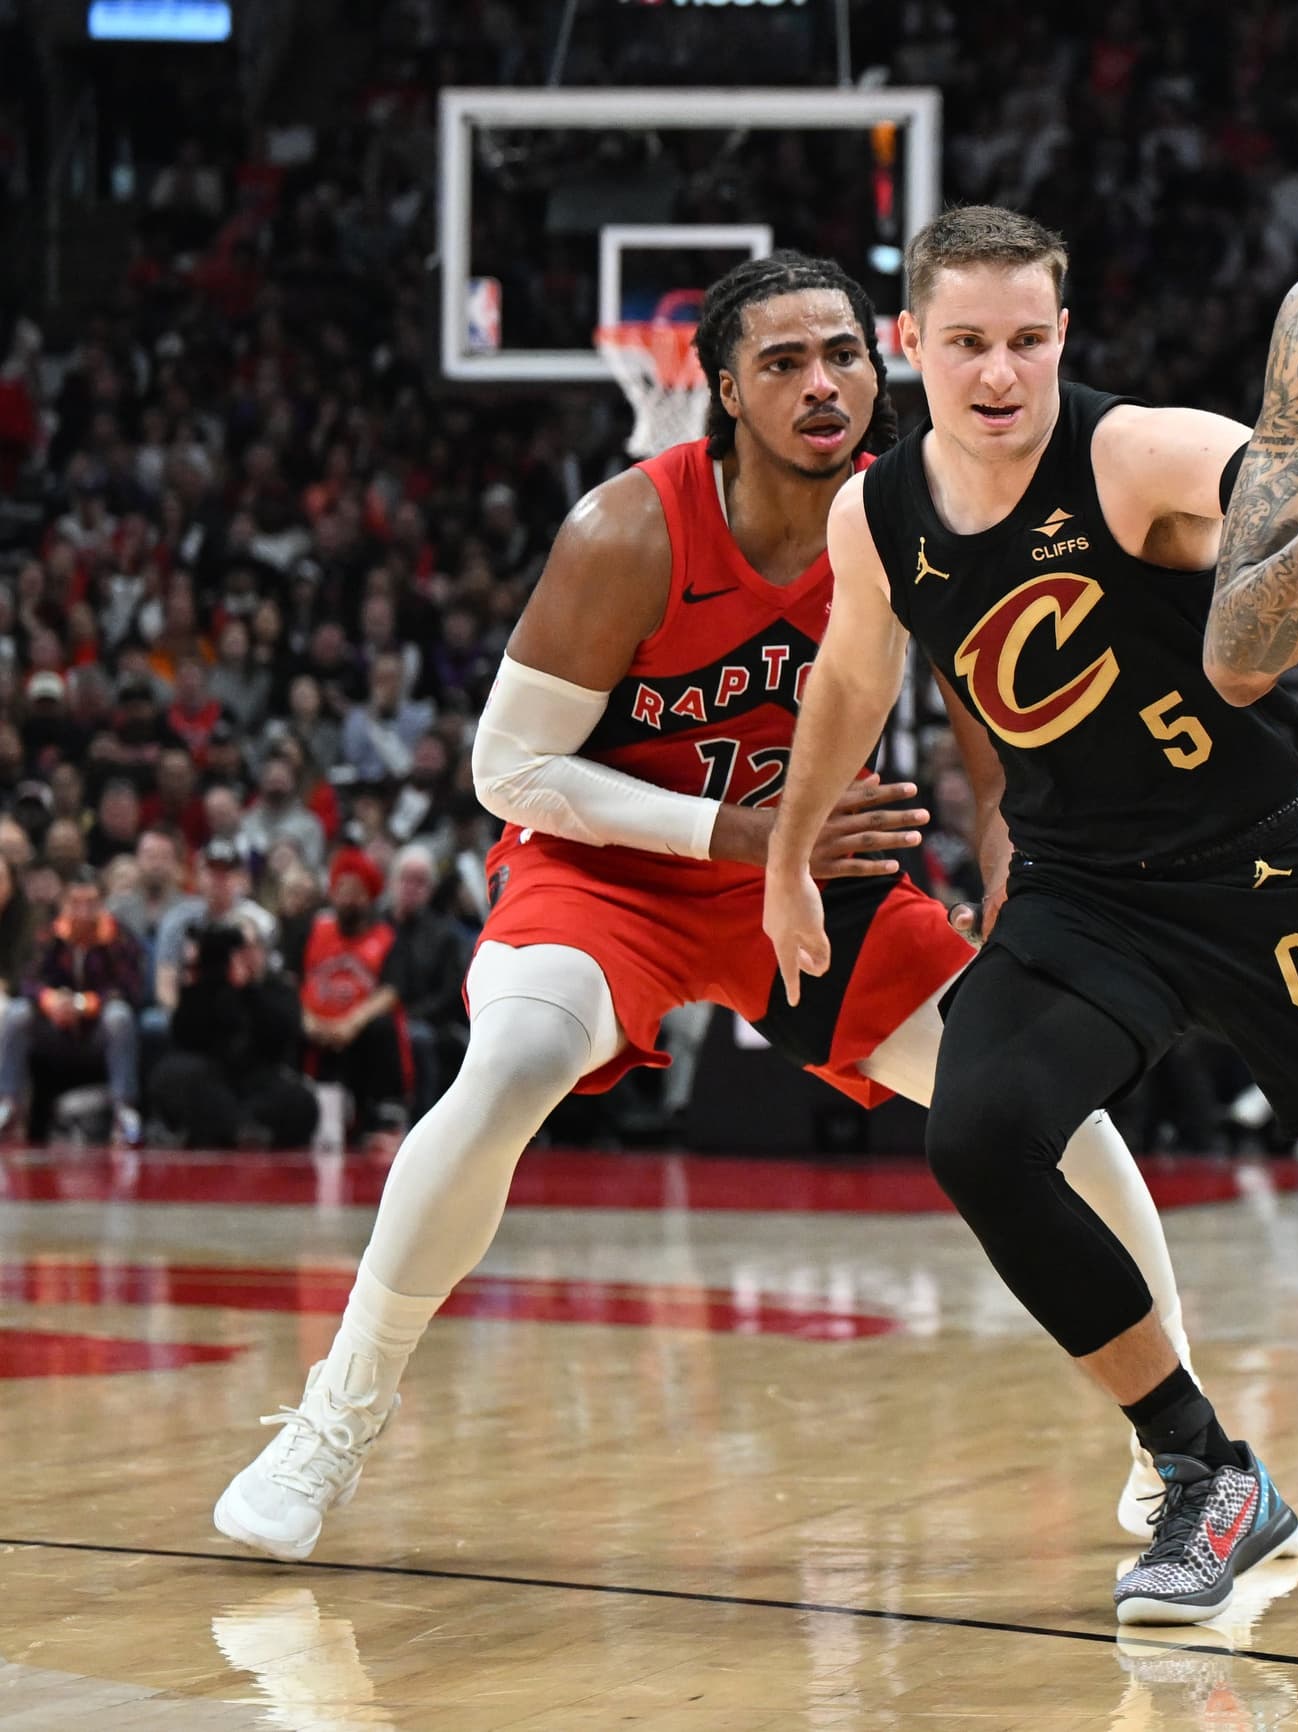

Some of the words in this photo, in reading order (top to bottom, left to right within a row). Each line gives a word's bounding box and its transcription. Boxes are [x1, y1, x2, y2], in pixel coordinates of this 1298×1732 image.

[1031, 536, 1090, 562] CLIFFS
[954, 572, 1121, 749] C
[1138, 690, 1213, 770] 5
[694, 737, 791, 811] 12
